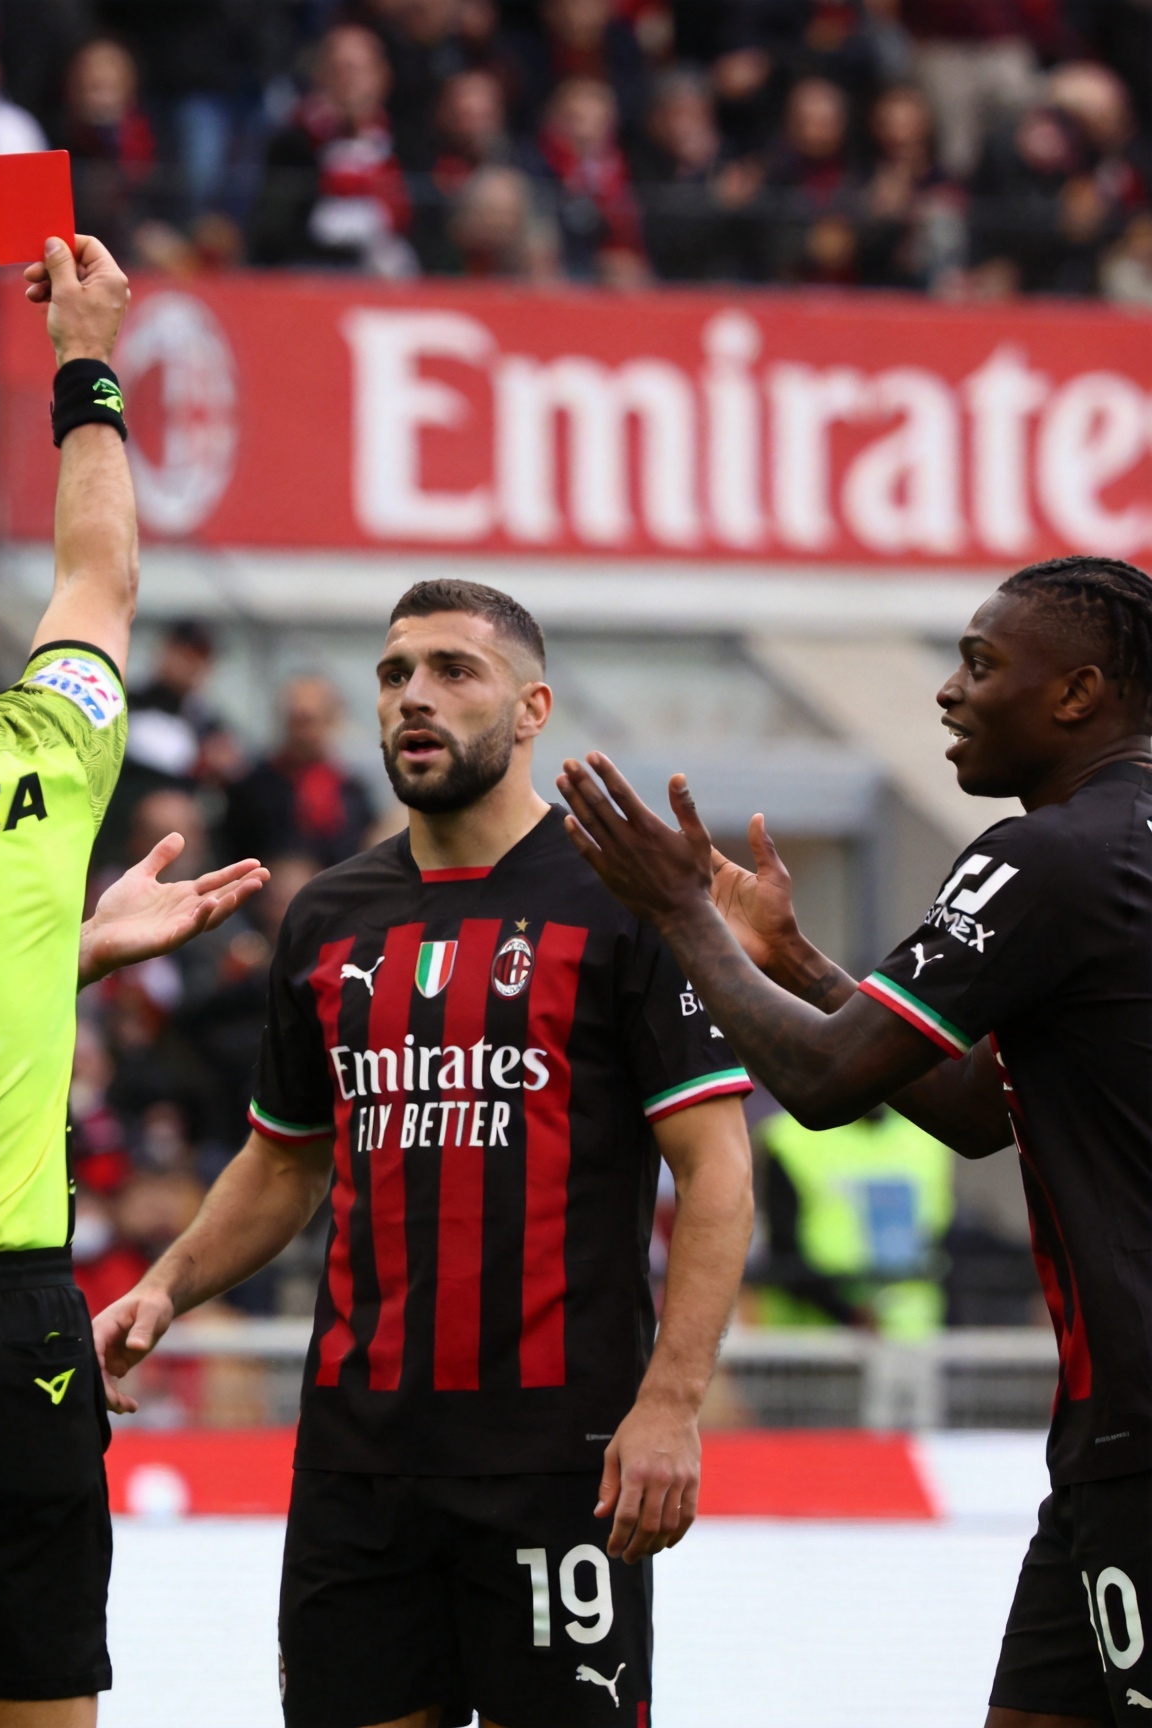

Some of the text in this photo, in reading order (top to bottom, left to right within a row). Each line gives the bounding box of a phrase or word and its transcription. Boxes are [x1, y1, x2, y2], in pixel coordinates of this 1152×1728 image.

[330, 1034, 550, 1101] Emirates
[358, 1101, 511, 1152] FLY BETTER
[516, 1543, 614, 1648] 19
